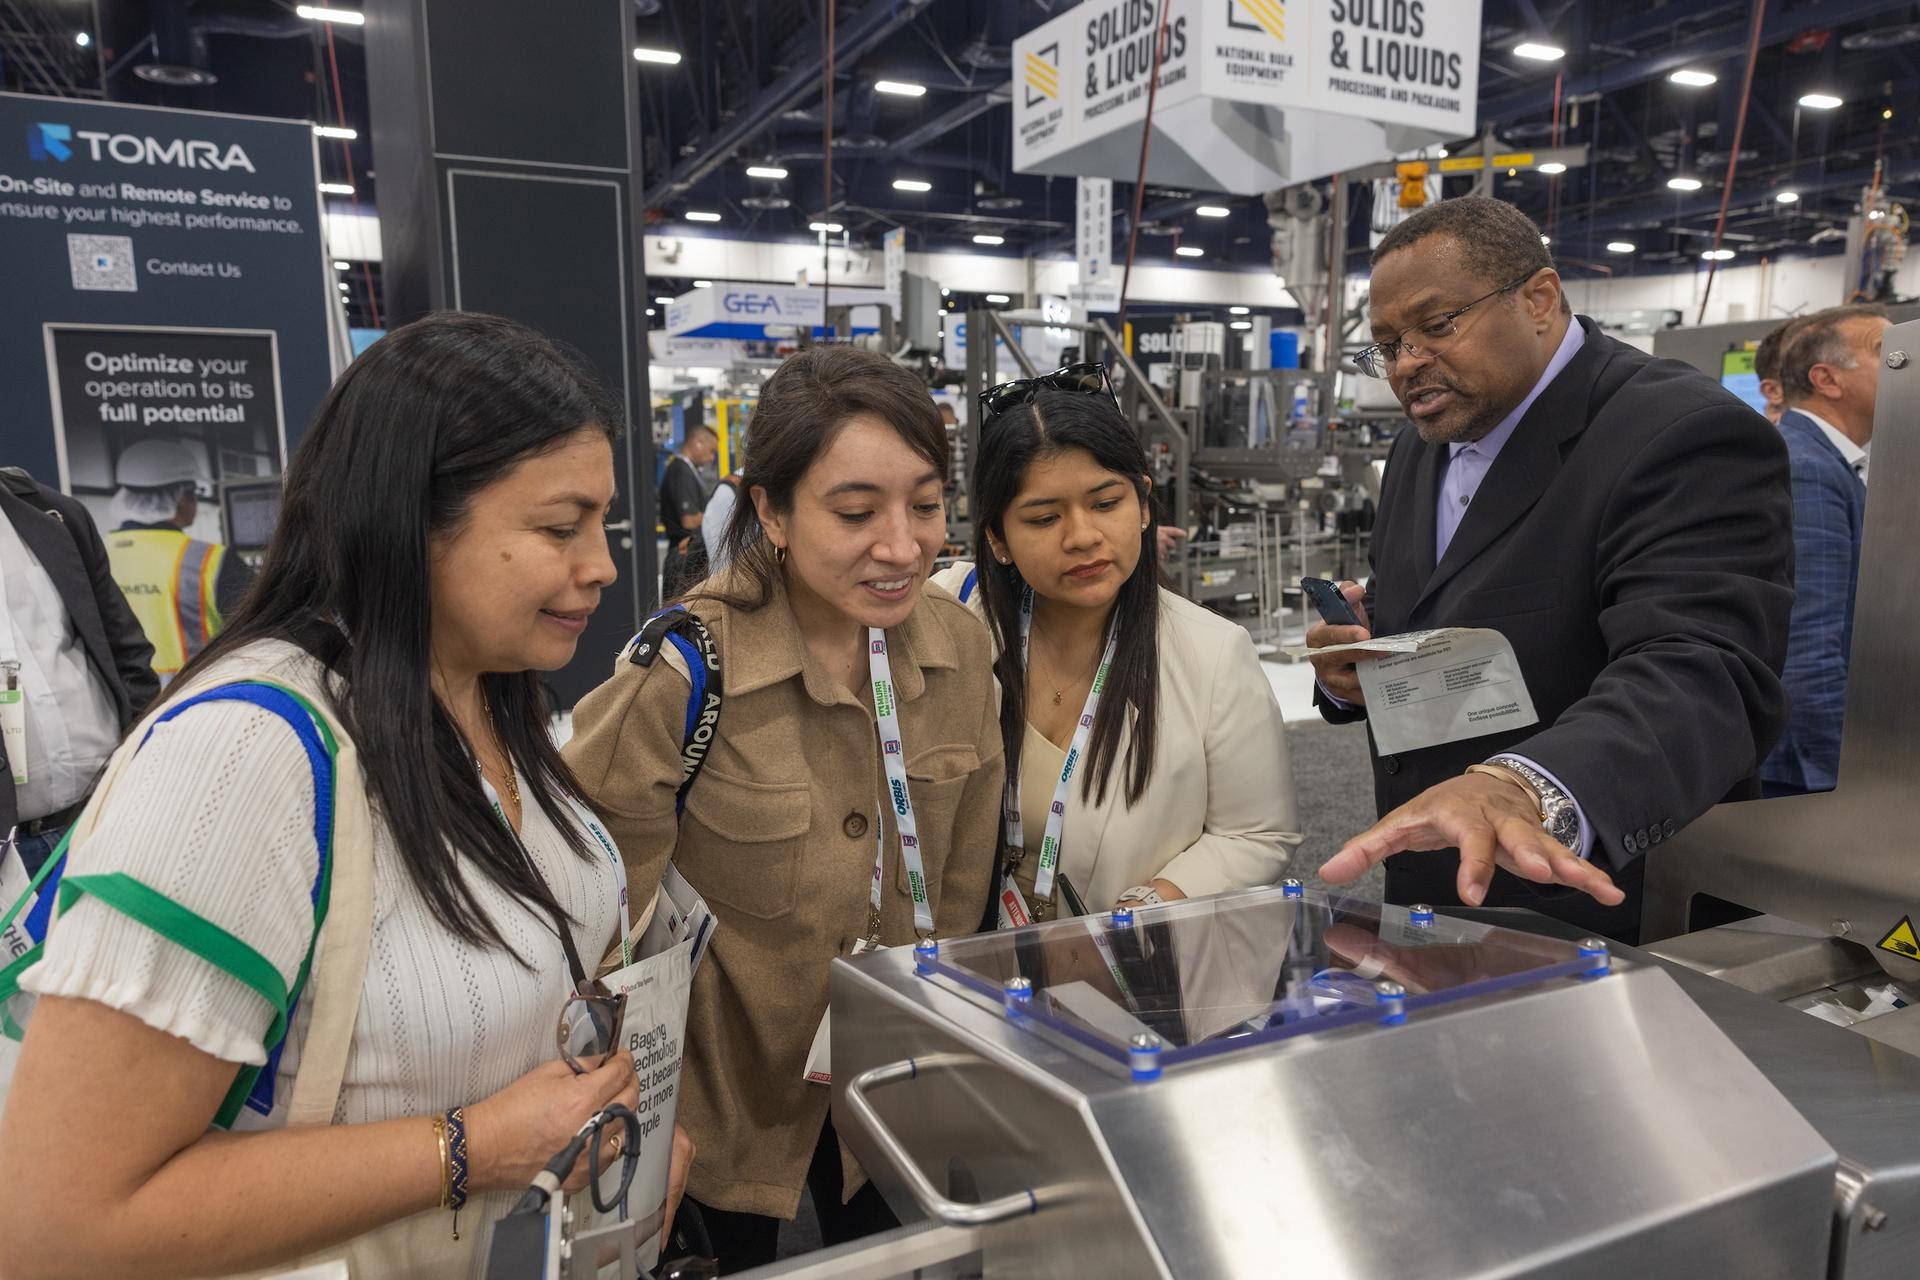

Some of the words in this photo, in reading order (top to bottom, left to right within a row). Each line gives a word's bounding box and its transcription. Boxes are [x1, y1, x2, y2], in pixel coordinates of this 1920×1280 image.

[1216, 45, 1266, 62] NATIONAL
[1269, 52, 1294, 67] BULK
[1330, 30, 1351, 70] &
[1362, 35, 1462, 90] LIQUIDS
[1085, 61, 1099, 99] &
[1226, 65, 1284, 81] EQUIPMENT
[1329, 77, 1387, 99] PROCESSING
[1391, 88, 1408, 104] AND
[1412, 92, 1460, 113] PACKAGING
[76, 131, 257, 173] TOMRA
[0, 174, 74, 198] On-Site
[79, 183, 117, 199] and
[121, 184, 197, 205] Remote
[201, 189, 270, 210] Service
[273, 195, 291, 211] to
[0, 202, 59, 219] nsure
[63, 206, 107, 224] your
[111, 206, 181, 227] highest
[185, 212, 303, 234] performance.
[146, 258, 214, 277] Contact
[218, 263, 241, 279] Us
[723, 293, 781, 315] GEA
[85, 352, 193, 379] Optimize
[198, 358, 248, 379] your
[85, 379, 196, 404] operation
[201, 383, 224, 400] to
[229, 380, 254, 400] its
[99, 402, 137, 422] full
[144, 404, 245, 426] potential
[682, 692, 721, 781] AROUN
[1061, 747, 1077, 782] ORBIS
[893, 779, 907, 816] ORBIS
[630, 1023, 667, 1051] Bagging
[634, 1038, 677, 1072] echnology
[640, 1073, 650, 1092] st
[652, 1057, 681, 1087] became
[638, 1094, 652, 1113] ot
[653, 1084, 673, 1108] more
